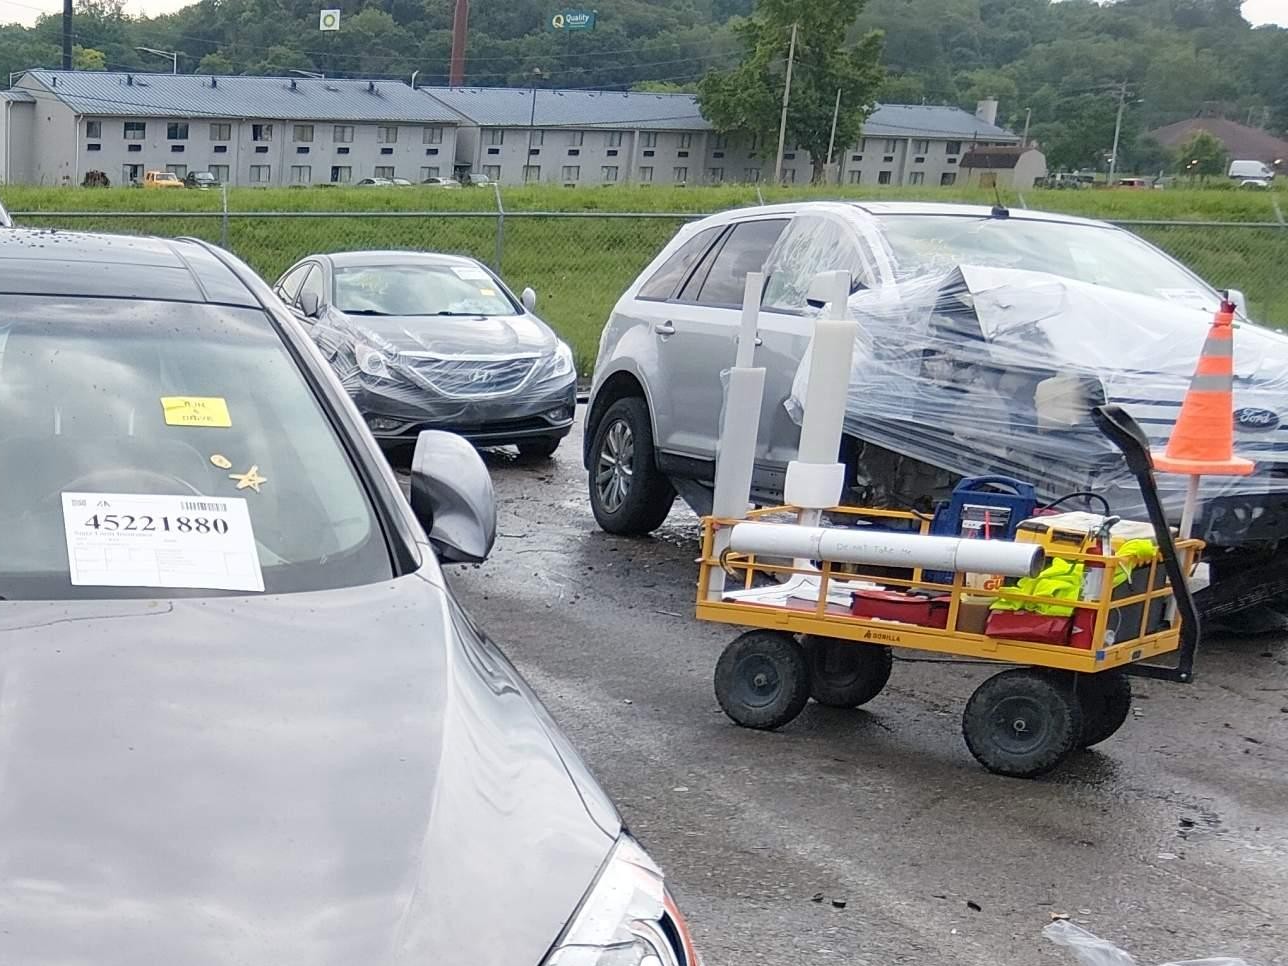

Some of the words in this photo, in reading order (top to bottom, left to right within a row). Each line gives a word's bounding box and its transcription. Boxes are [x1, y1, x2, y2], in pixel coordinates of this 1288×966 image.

[566, 13, 589, 24] Quality
[1239, 408, 1272, 424] Ford
[84, 514, 229, 535] 45221880
[872, 632, 901, 642] GORILLA
